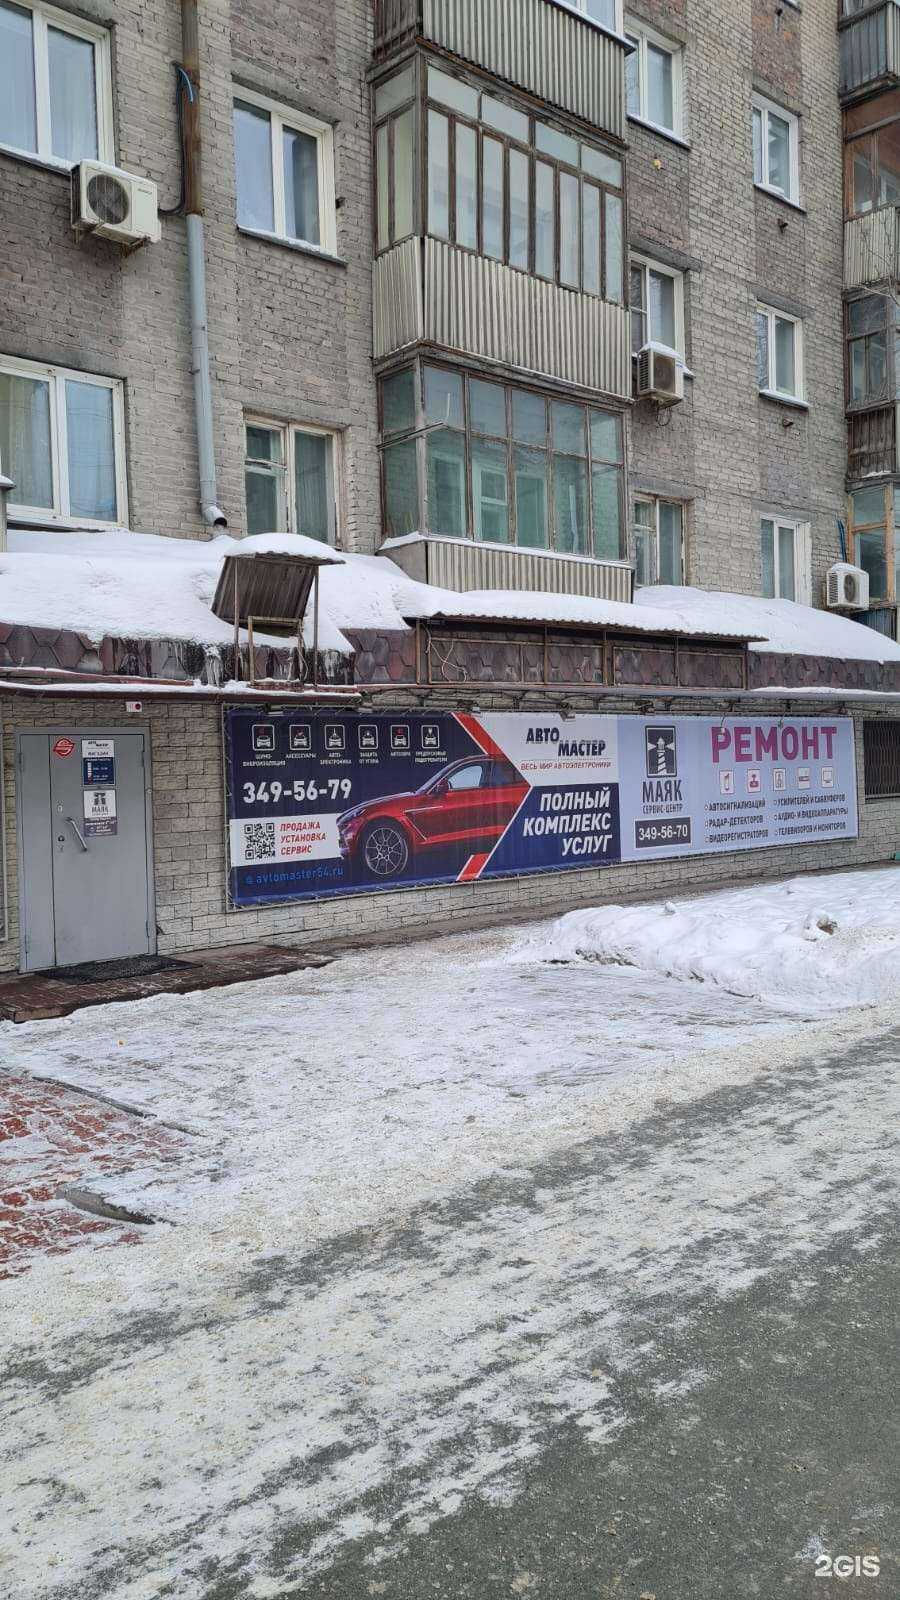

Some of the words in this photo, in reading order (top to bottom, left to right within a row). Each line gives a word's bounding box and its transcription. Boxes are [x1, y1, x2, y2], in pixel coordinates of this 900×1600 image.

[526, 728, 560, 743] АВТО
[711, 726, 837, 763] РЕМОНТ
[558, 741, 606, 757] МАСТЕР
[243, 779, 352, 804] 349-56-79
[540, 786, 611, 812] ПОЛНЫЙ
[642, 780, 682, 803] МАЯК
[642, 804, 683, 815] СЕРВИС-ЦЕНТР
[280, 821, 321, 833] ПРОДАЖА
[523, 813, 611, 837] КОМПЛЕКС
[638, 824, 688, 842] 349-56-70
[281, 832, 327, 844] УСТАНОВКА
[562, 834, 613, 856] УСЛУГ
[281, 845, 313, 856] СЕРВИС
